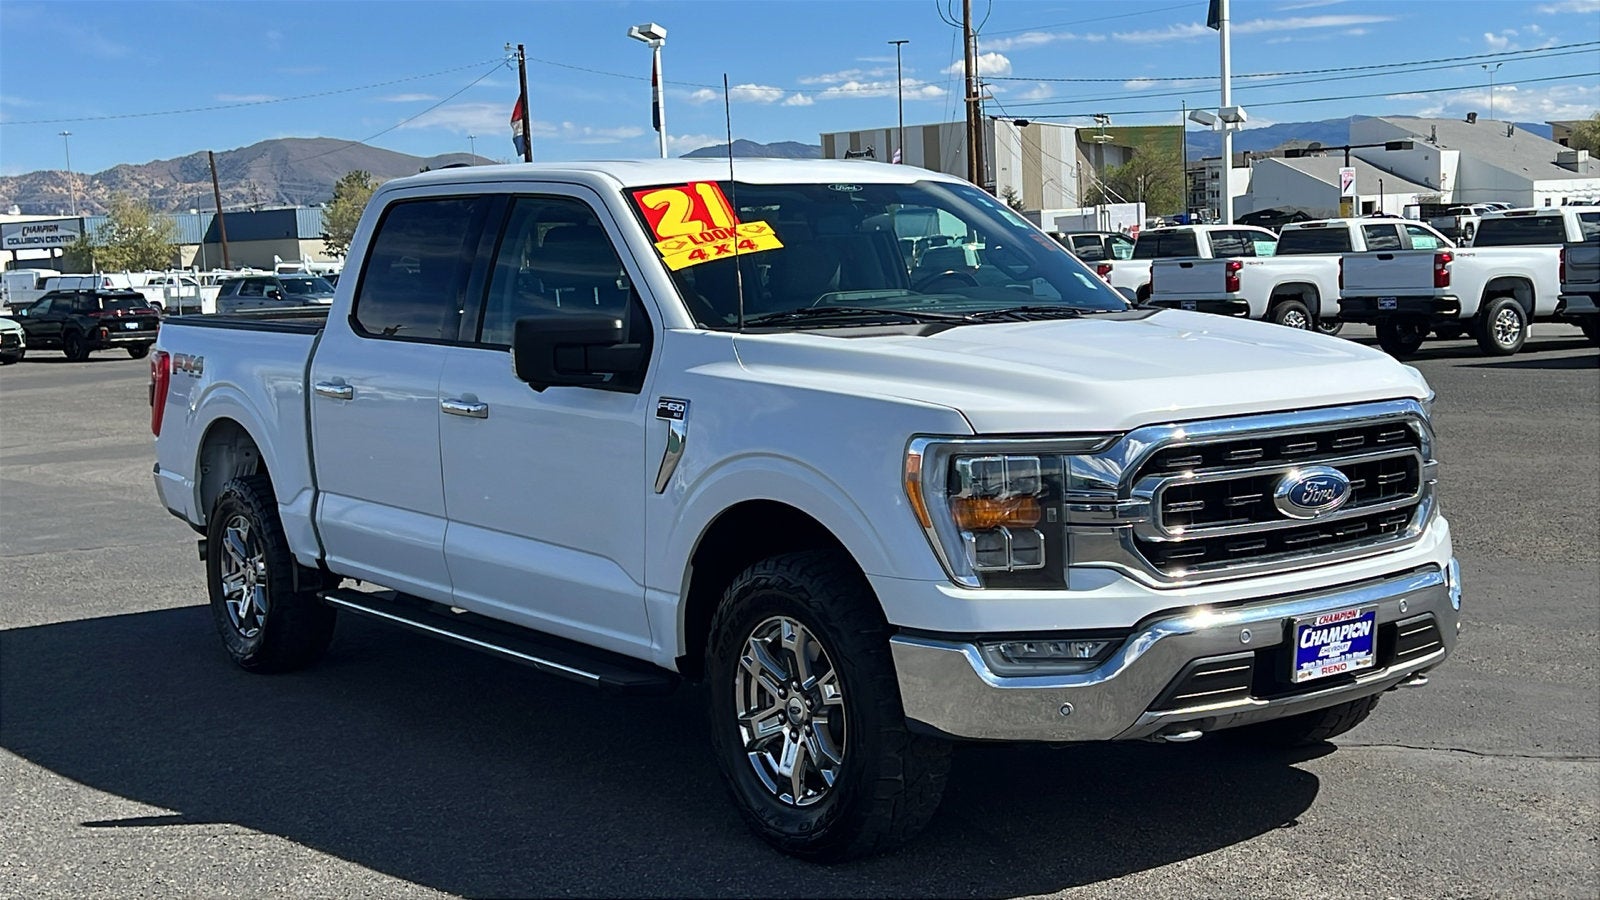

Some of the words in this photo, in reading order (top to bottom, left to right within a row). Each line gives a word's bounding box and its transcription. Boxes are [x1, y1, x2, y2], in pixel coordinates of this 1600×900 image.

[641, 182, 735, 237] 21
[7, 236, 45, 245] COLLISION
[46, 235, 76, 244] CENTER
[22, 225, 59, 236] CHAMPION
[688, 226, 742, 246] LOOK
[172, 352, 204, 375] FX4
[1301, 480, 1337, 505] Ford
[1319, 609, 1358, 625] CHAMPION
[1300, 620, 1373, 649] CHAMPION
[1321, 662, 1348, 675] RENO
